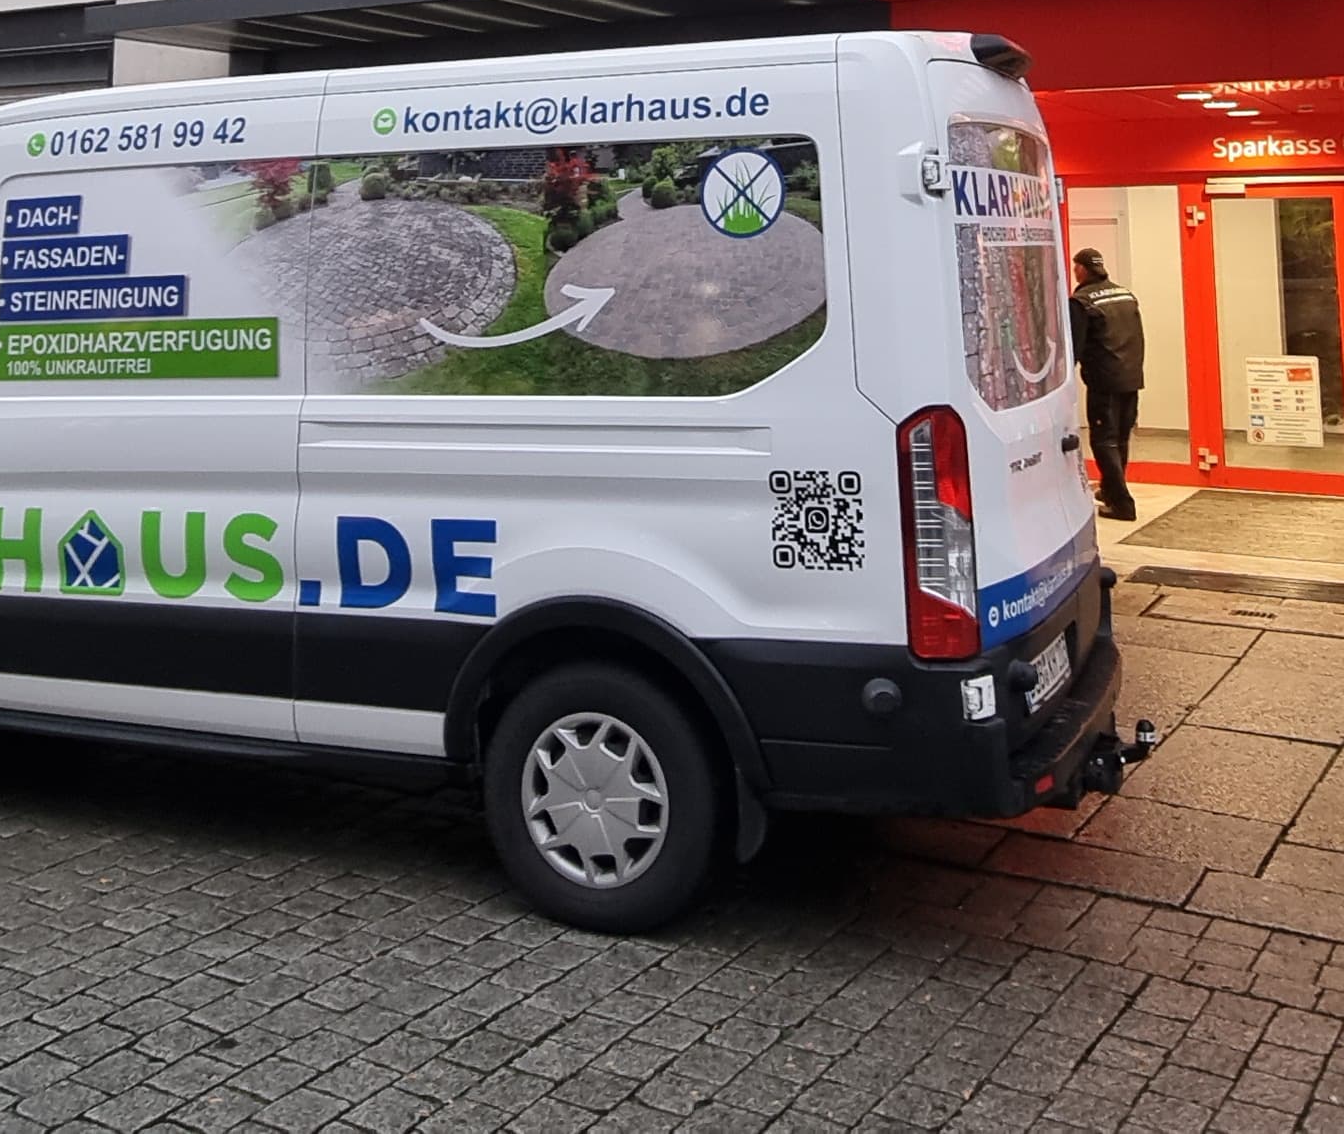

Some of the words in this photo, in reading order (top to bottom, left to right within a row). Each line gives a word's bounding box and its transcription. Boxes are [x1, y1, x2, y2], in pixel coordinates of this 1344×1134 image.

[403, 86, 770, 135] kontakt@klarhaus.de
[50, 127, 110, 156] 0162
[117, 123, 163, 151] 581
[172, 120, 205, 148] 99
[213, 117, 247, 144] 42
[1213, 134, 1337, 162] Sparkasse
[17, 206, 79, 229] DACH-
[13, 245, 125, 270] FASSADEN-
[10, 286, 179, 313] STEINREINIGUNG
[7, 328, 273, 356] EPOXIDHARZVERFUGUNG
[6, 360, 42, 376] 100%
[45, 358, 152, 376] UNKRAUTFREI
